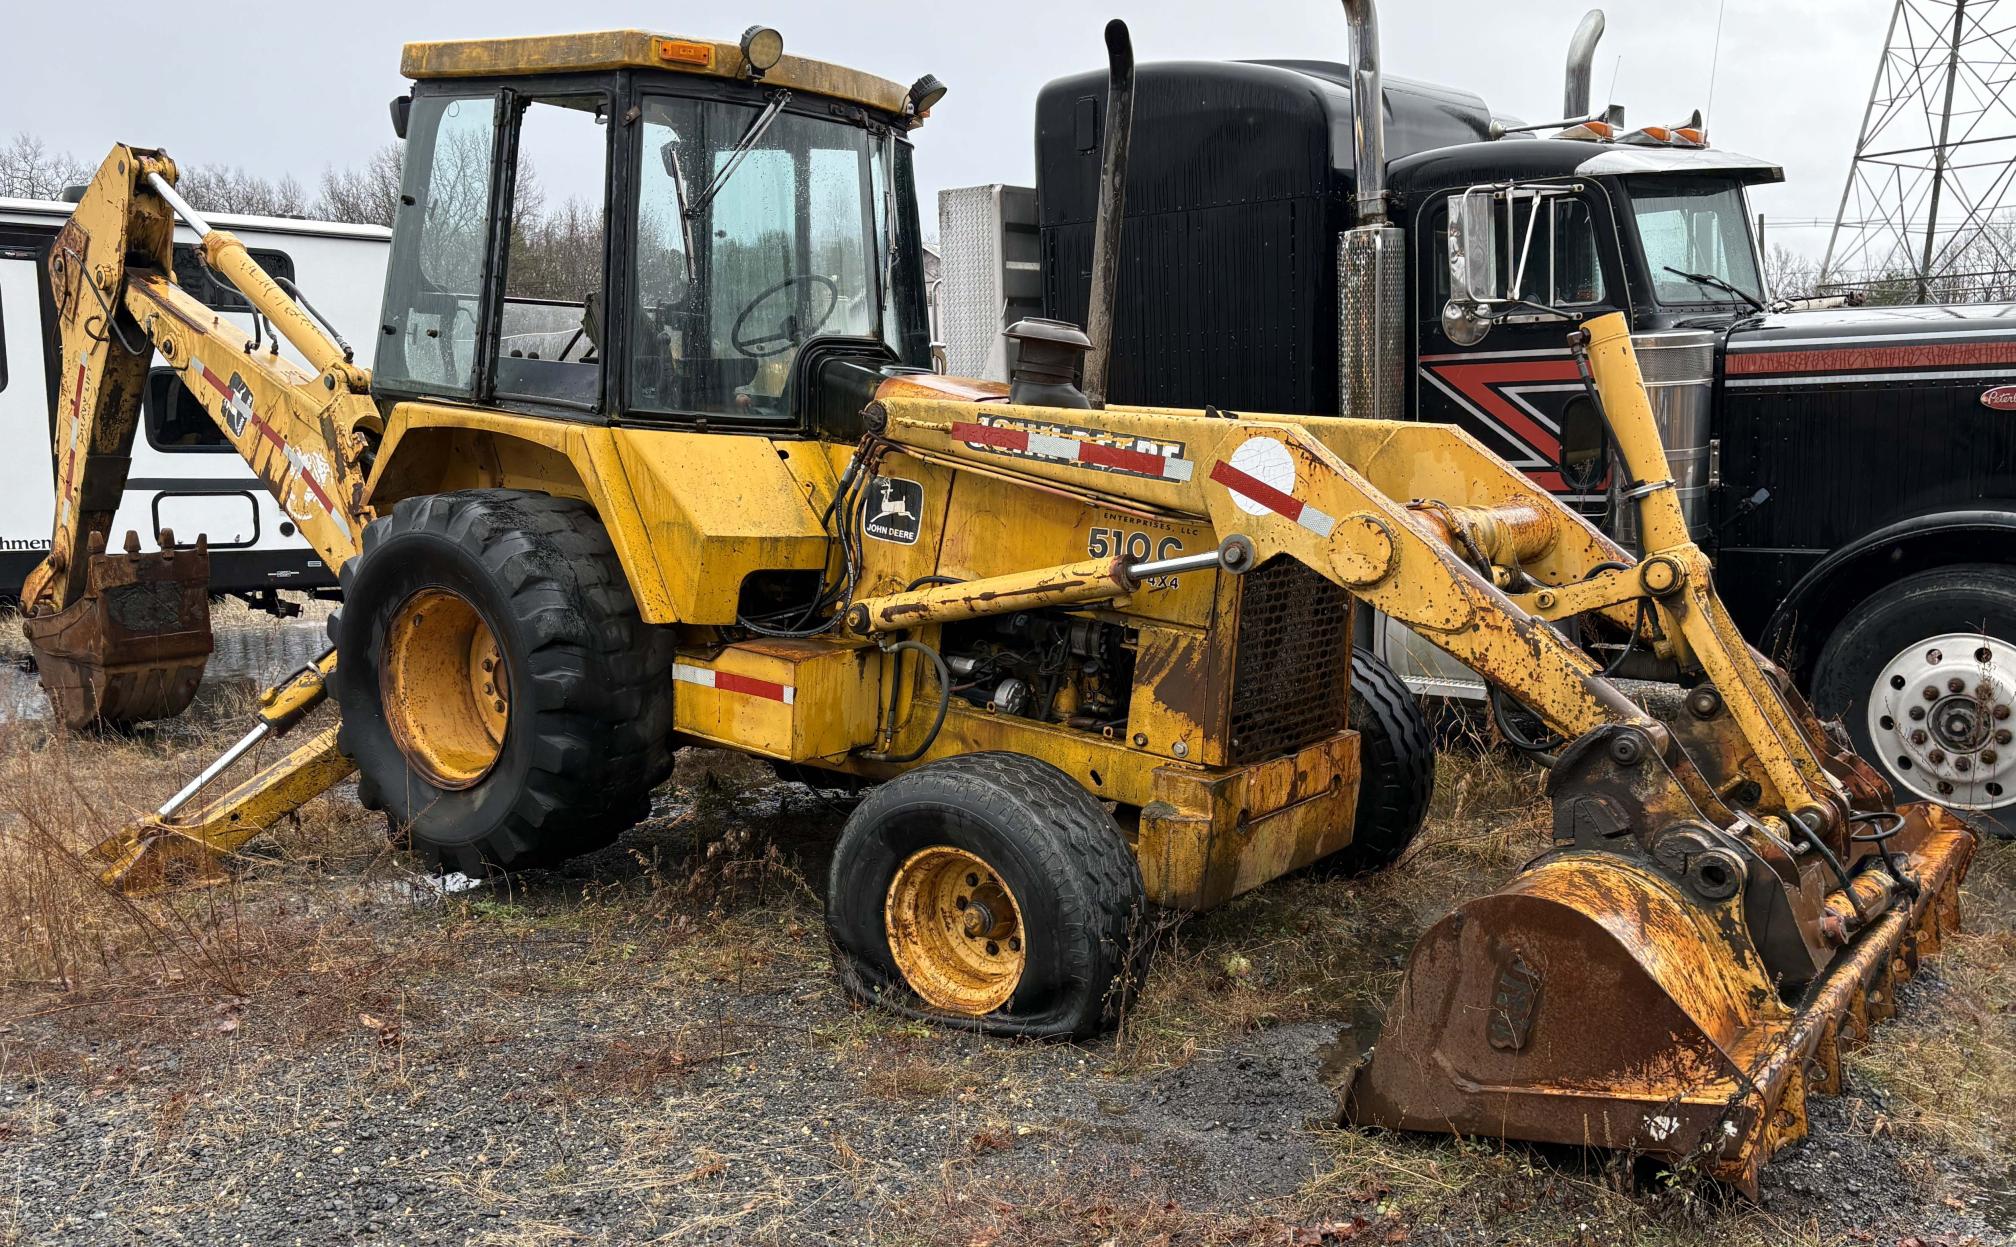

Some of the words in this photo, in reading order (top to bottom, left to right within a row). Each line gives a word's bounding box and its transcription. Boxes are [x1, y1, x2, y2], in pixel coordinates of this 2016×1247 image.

[866, 523, 888, 535] JOHN
[888, 527, 915, 540] DEERE
[1181, 527, 1199, 536] LLC
[1147, 575, 1179, 589] 4X4
